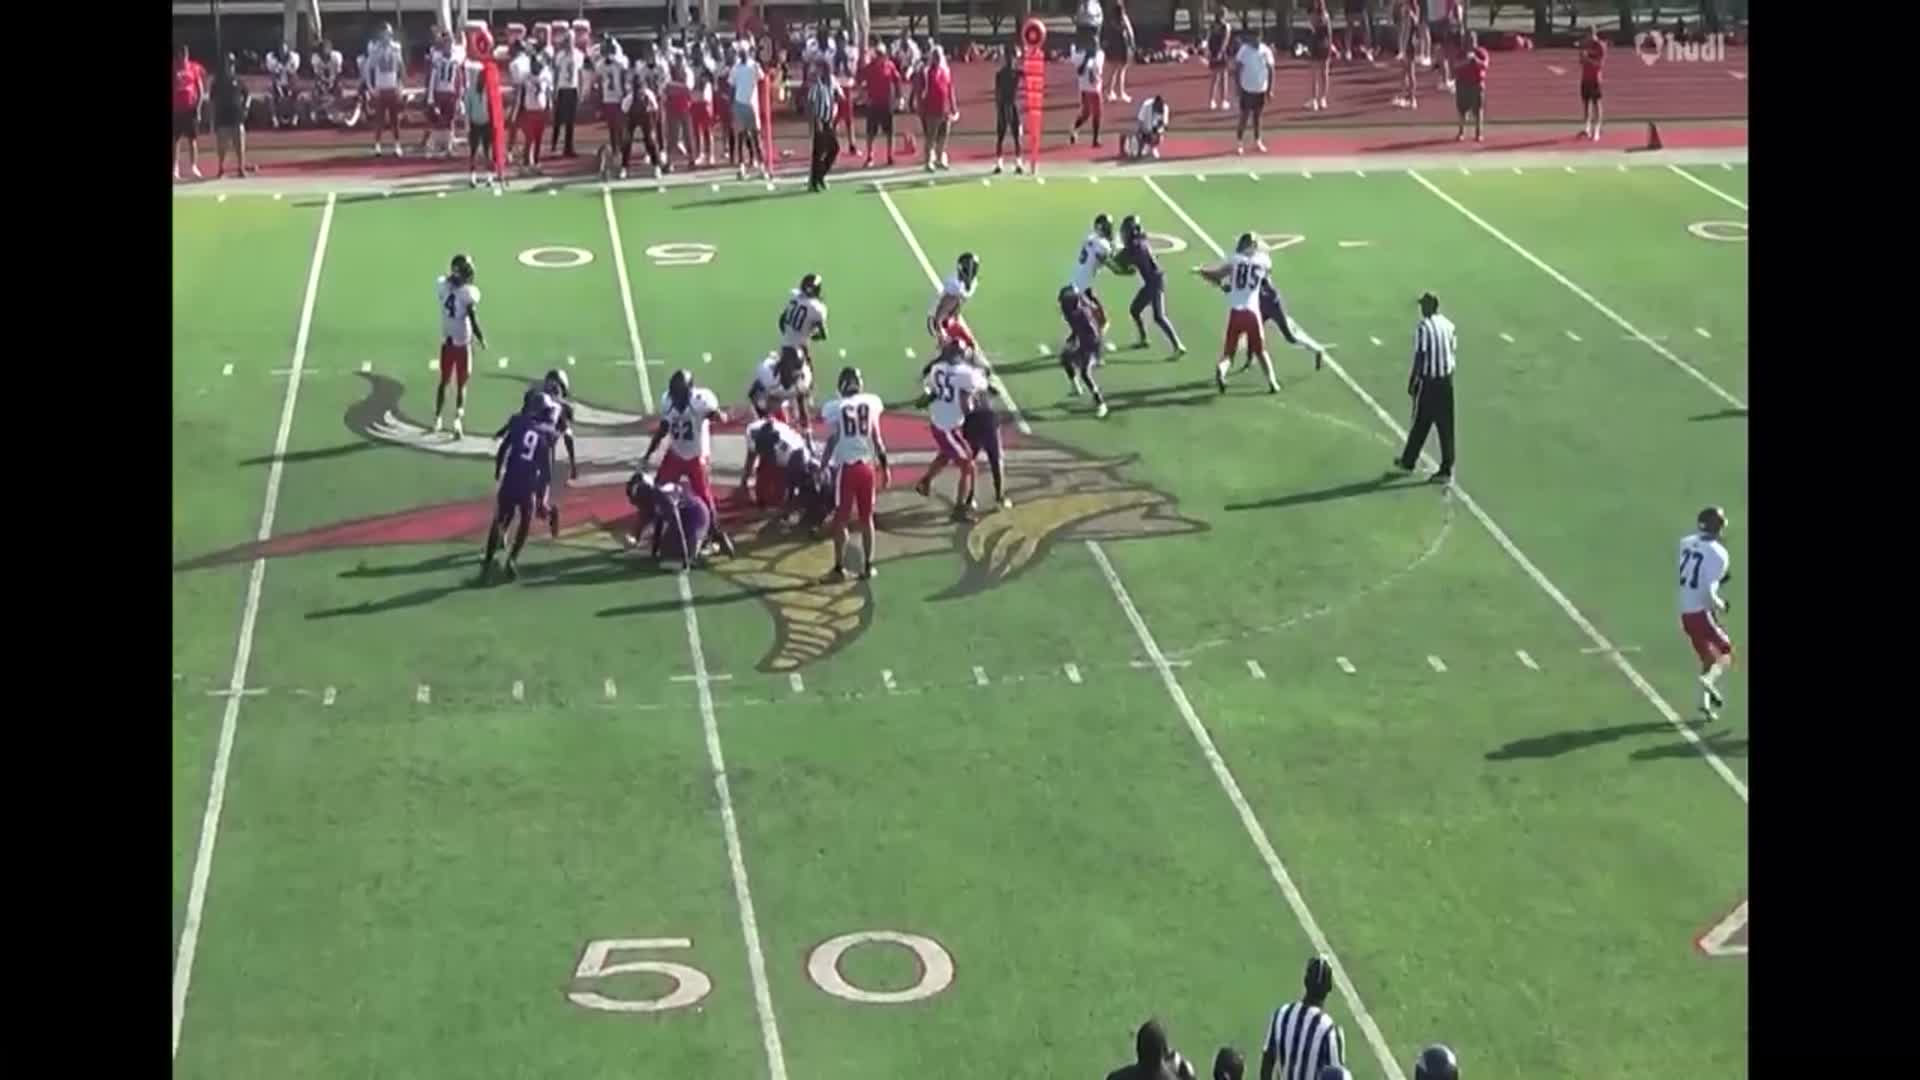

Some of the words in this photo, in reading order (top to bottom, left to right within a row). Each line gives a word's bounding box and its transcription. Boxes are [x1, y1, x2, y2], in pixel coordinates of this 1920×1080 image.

[1235, 263, 1261, 290] 85
[444, 293, 457, 318] 4
[841, 403, 870, 437] 68
[520, 430, 539, 461] 9
[1680, 548, 1704, 589] 27
